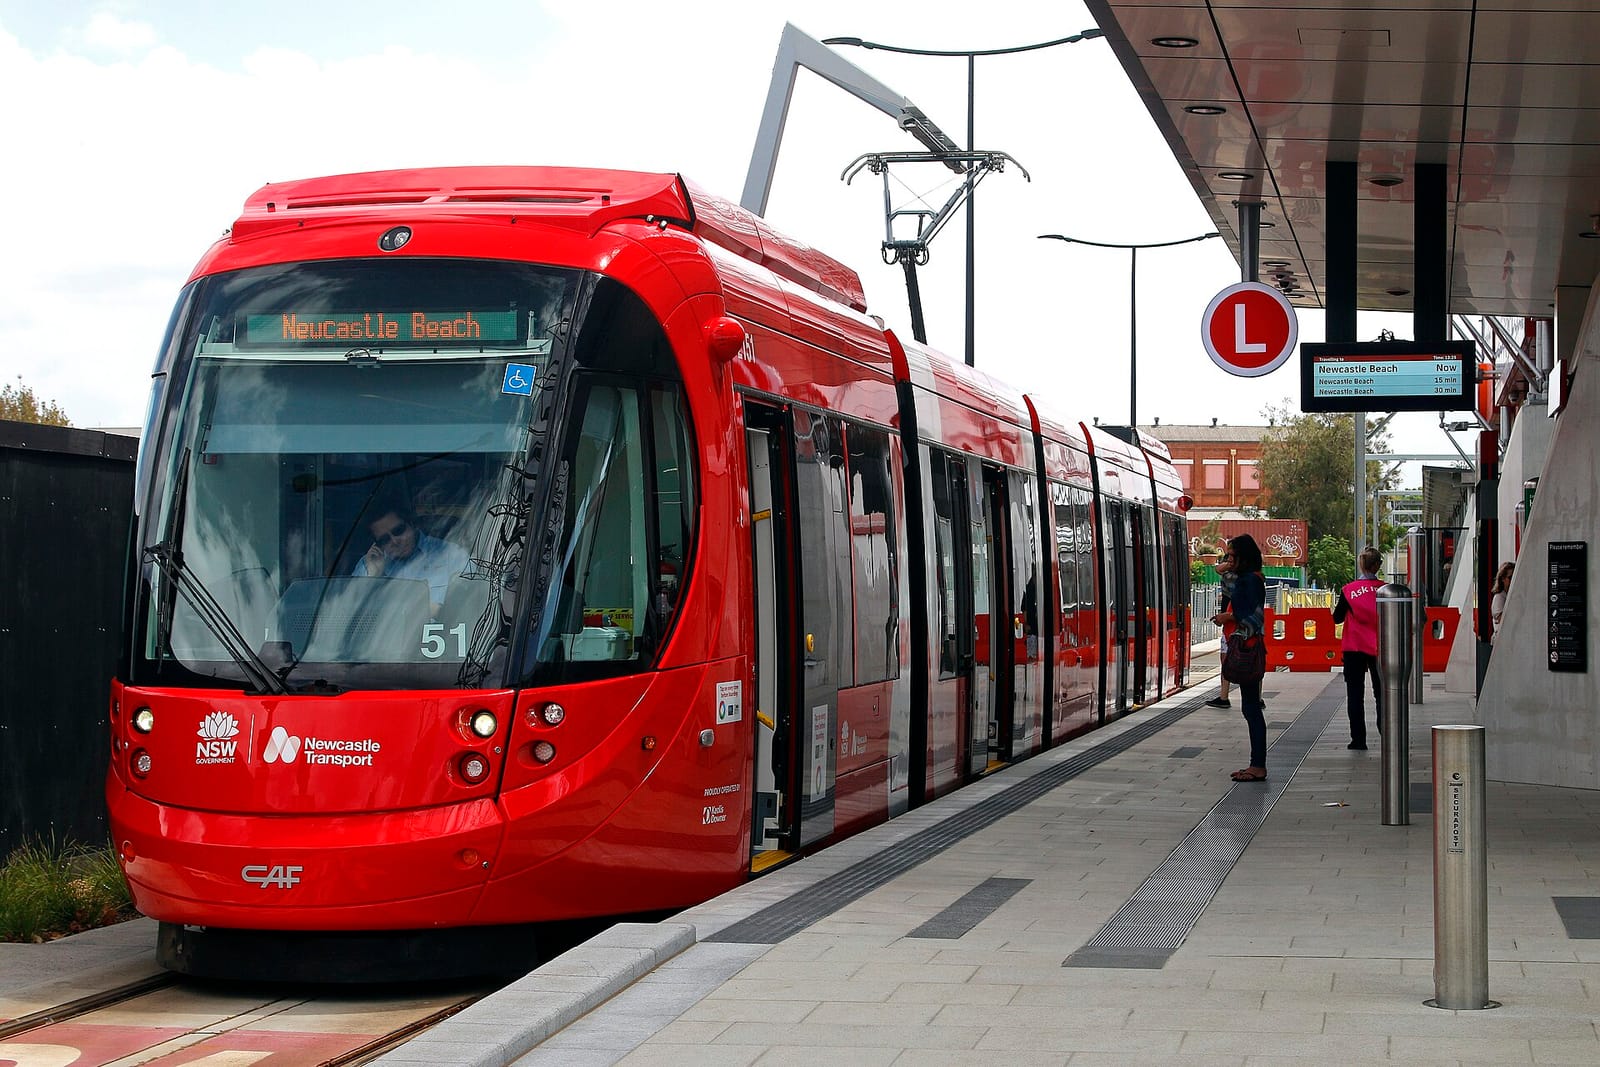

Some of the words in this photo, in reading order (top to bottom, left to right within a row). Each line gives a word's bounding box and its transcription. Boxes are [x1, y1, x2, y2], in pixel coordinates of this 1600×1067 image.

[281, 312, 398, 339] Newcastle
[412, 311, 480, 338] Beach
[1234, 303, 1267, 353] L
[1319, 365, 1367, 373] Newcastle
[1370, 364, 1398, 373] Beach
[1436, 363, 1457, 372] Now
[1434, 376, 1443, 384] 15
[1351, 585, 1369, 600] Ask
[420, 623, 467, 658] 51
[196, 741, 237, 757] NSW
[304, 737, 381, 752] Newcastle
[195, 757, 235, 765] GOVERNMENT
[304, 751, 373, 767] Transport
[241, 865, 303, 889] CAF
